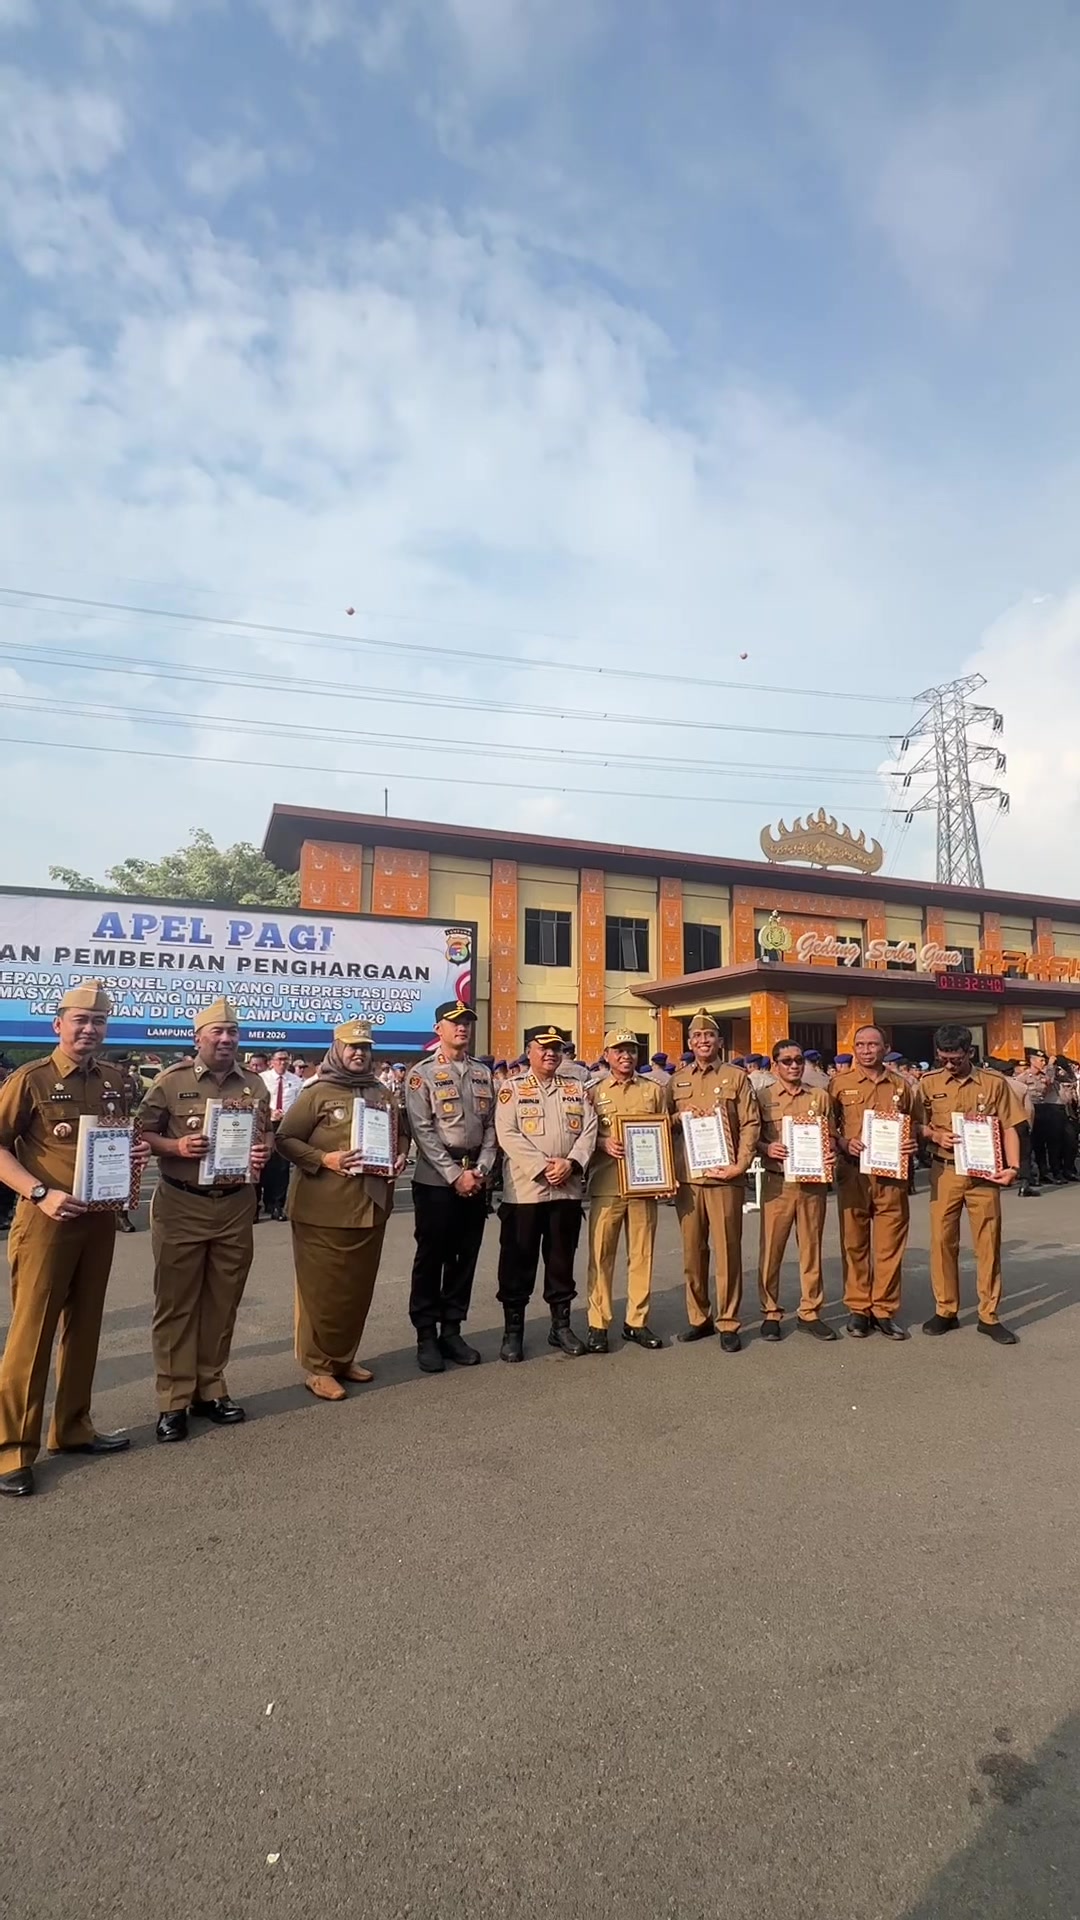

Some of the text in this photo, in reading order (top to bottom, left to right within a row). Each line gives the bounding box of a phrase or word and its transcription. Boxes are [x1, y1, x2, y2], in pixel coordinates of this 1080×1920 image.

[92, 911, 334, 951] APEL PAGI
[54, 947, 225, 971] PEMBERIAN
[237, 957, 431, 981] PENGHARGAAN
[797, 932, 962, 969] Gedung Serba Guna
[0, 971, 63, 986] EPADA
[171, 978, 223, 993] POLRI
[229, 981, 274, 996] YANG
[279, 983, 386, 1000] BERPRESTASI
[390, 988, 421, 1001] DAN
[132, 991, 181, 1005] YANG
[287, 997, 343, 1011] TUGAS
[361, 1001, 412, 1013] TUGAS
[150, 1006, 168, 1018] DI
[235, 1008, 316, 1022] LAMPUNG
[321, 1012, 345, 1023] T.A
[350, 1013, 386, 1025] 2026
[147, 1028, 287, 1039] LAMPUNG MEI 2026
